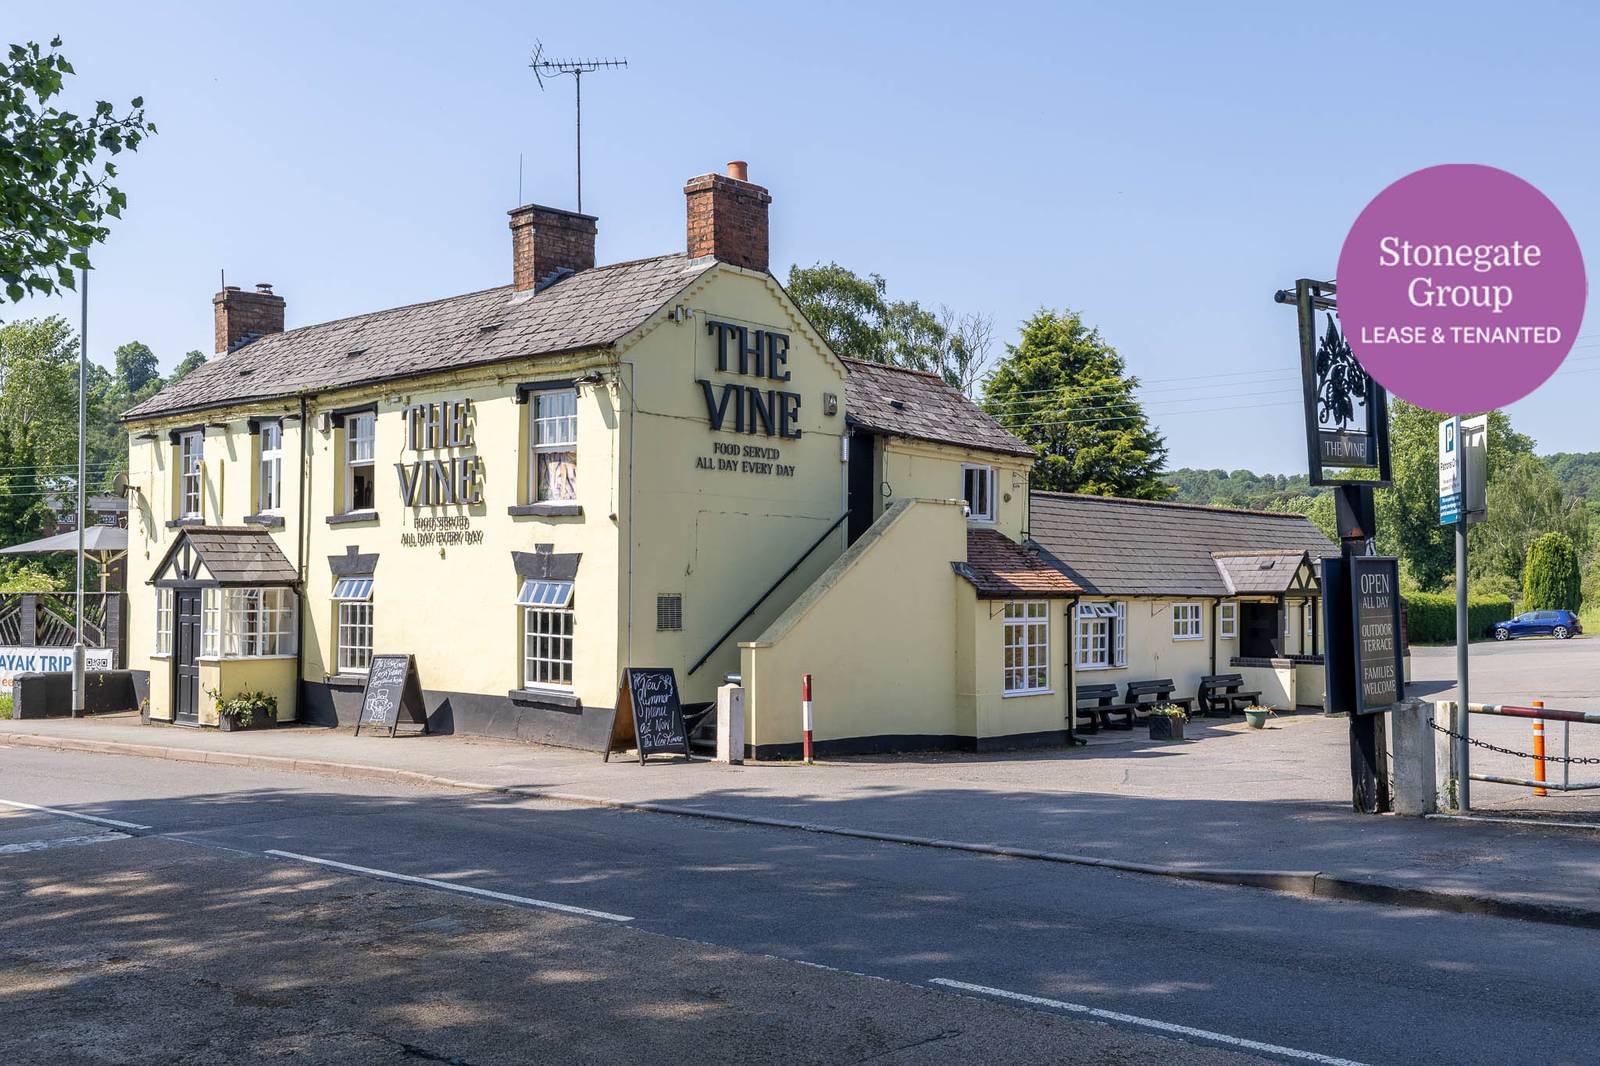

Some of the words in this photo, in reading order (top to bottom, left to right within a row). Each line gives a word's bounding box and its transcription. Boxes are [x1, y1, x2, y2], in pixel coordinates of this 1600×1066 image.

[707, 320, 791, 382] THE
[695, 379, 802, 440] VINE
[401, 398, 472, 451] THE
[713, 442, 741, 456] FOOD
[1324, 440, 1342, 457] THE
[1343, 441, 1365, 458] VINE
[695, 456, 715, 470] ALL
[719, 458, 739, 473] DAY
[742, 461, 773, 475] EVERY
[776, 464, 796, 478] DAY
[393, 455, 480, 508] VINE
[417, 532, 434, 545] DAY
[464, 530, 482, 544] DAY
[1360, 573, 1390, 595] OPEN
[1362, 597, 1375, 609] ALL
[1376, 596, 1390, 609] DAY
[1361, 623, 1393, 638] OUTDOOR
[1363, 637, 1393, 652] TERRACE
[1364, 665, 1394, 681] FAMILIES
[1363, 679, 1397, 696] WELCOME
